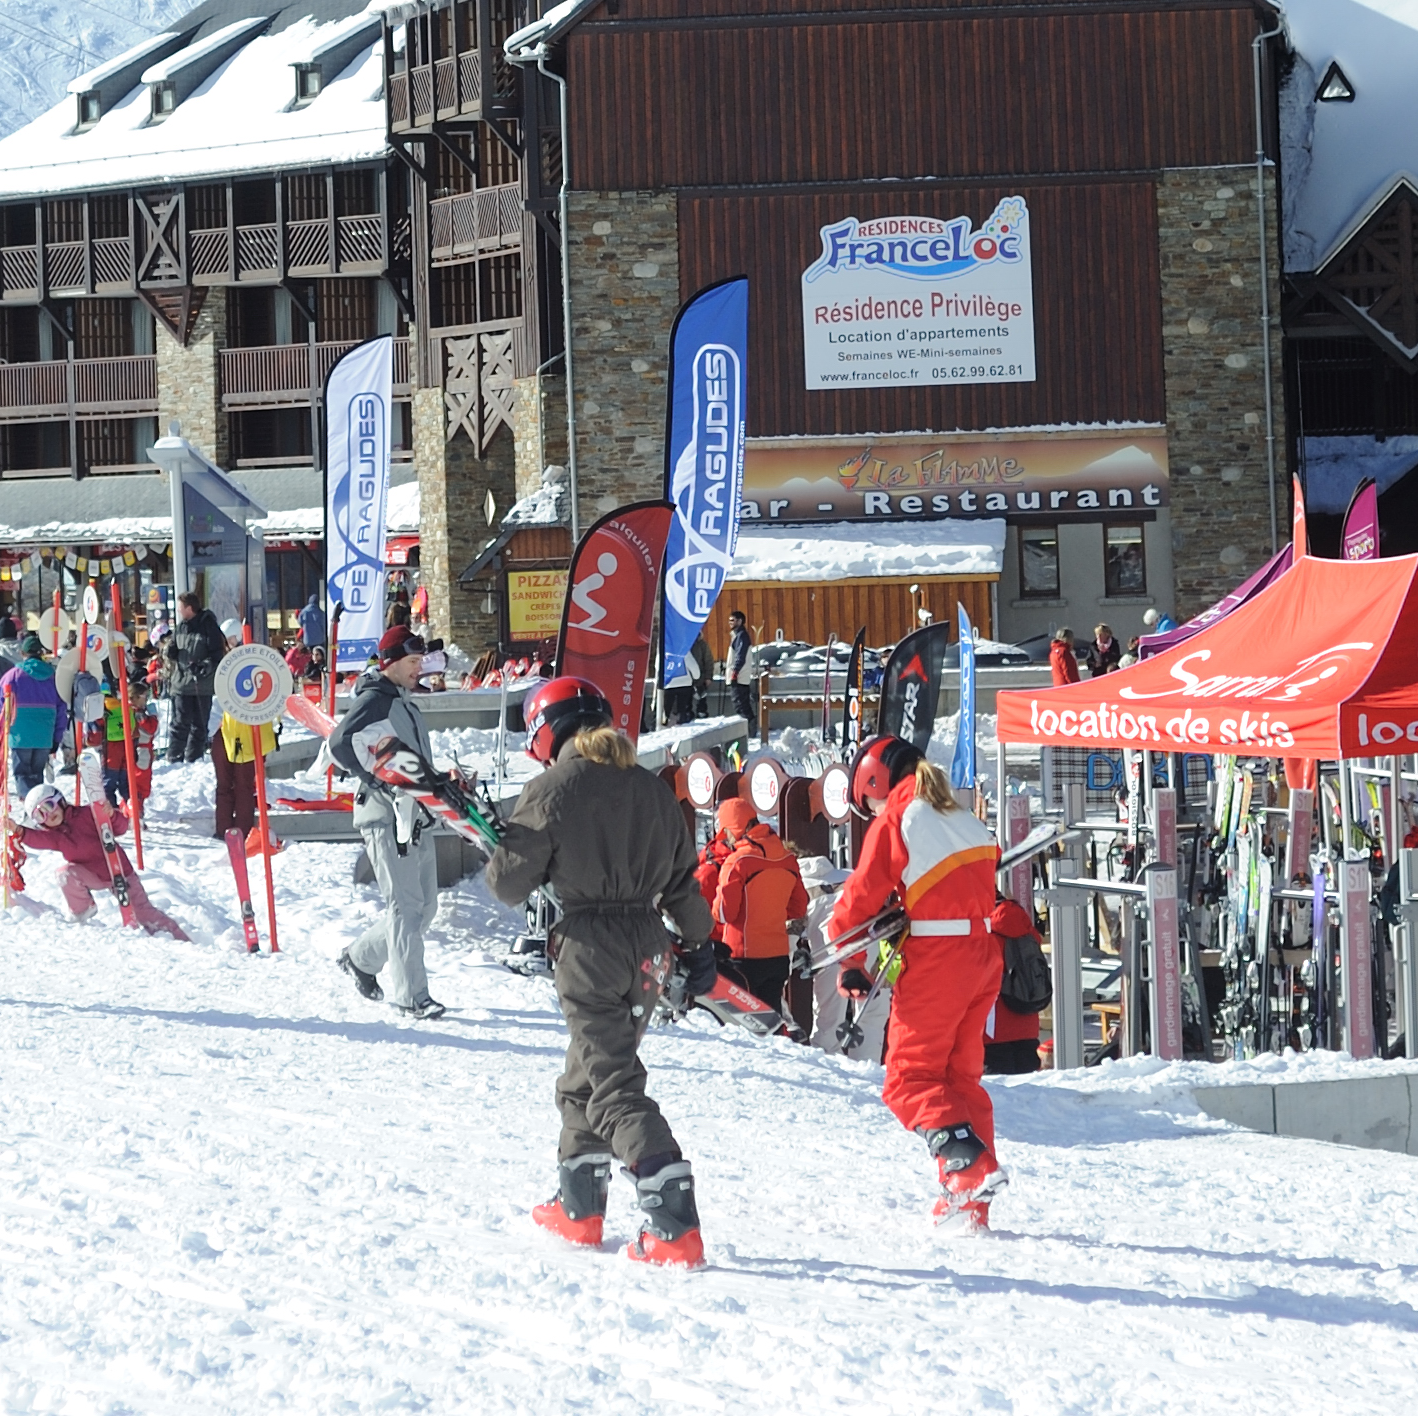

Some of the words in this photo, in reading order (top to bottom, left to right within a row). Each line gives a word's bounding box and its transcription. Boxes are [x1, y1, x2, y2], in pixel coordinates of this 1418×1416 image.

[827, 224, 1019, 268] FranceLoc
[858, 220, 944, 237] RESIDENCES
[815, 296, 923, 324] Résidence
[931, 292, 1022, 321] Privilège
[829, 330, 892, 344] Location
[896, 325, 1009, 342] d'appartements
[837, 351, 893, 362] Semaines
[897, 346, 1002, 359] WE-Mini-semaines
[820, 369, 919, 382] www.franceloc.fr
[932, 365, 1023, 379] 05.62.99.62.81
[741, 496, 789, 520] ar
[864, 482, 1161, 515] Restaurant
[609, 520, 655, 577] alquiler
[623, 660, 635, 705] skis
[1030, 700, 1161, 741] location
[1165, 709, 1209, 743] de
[1220, 711, 1295, 748] skis
[1163, 930, 1173, 971] gratuit
[1356, 921, 1365, 960] gratuit
[1166, 975, 1177, 1047] gardiennage
